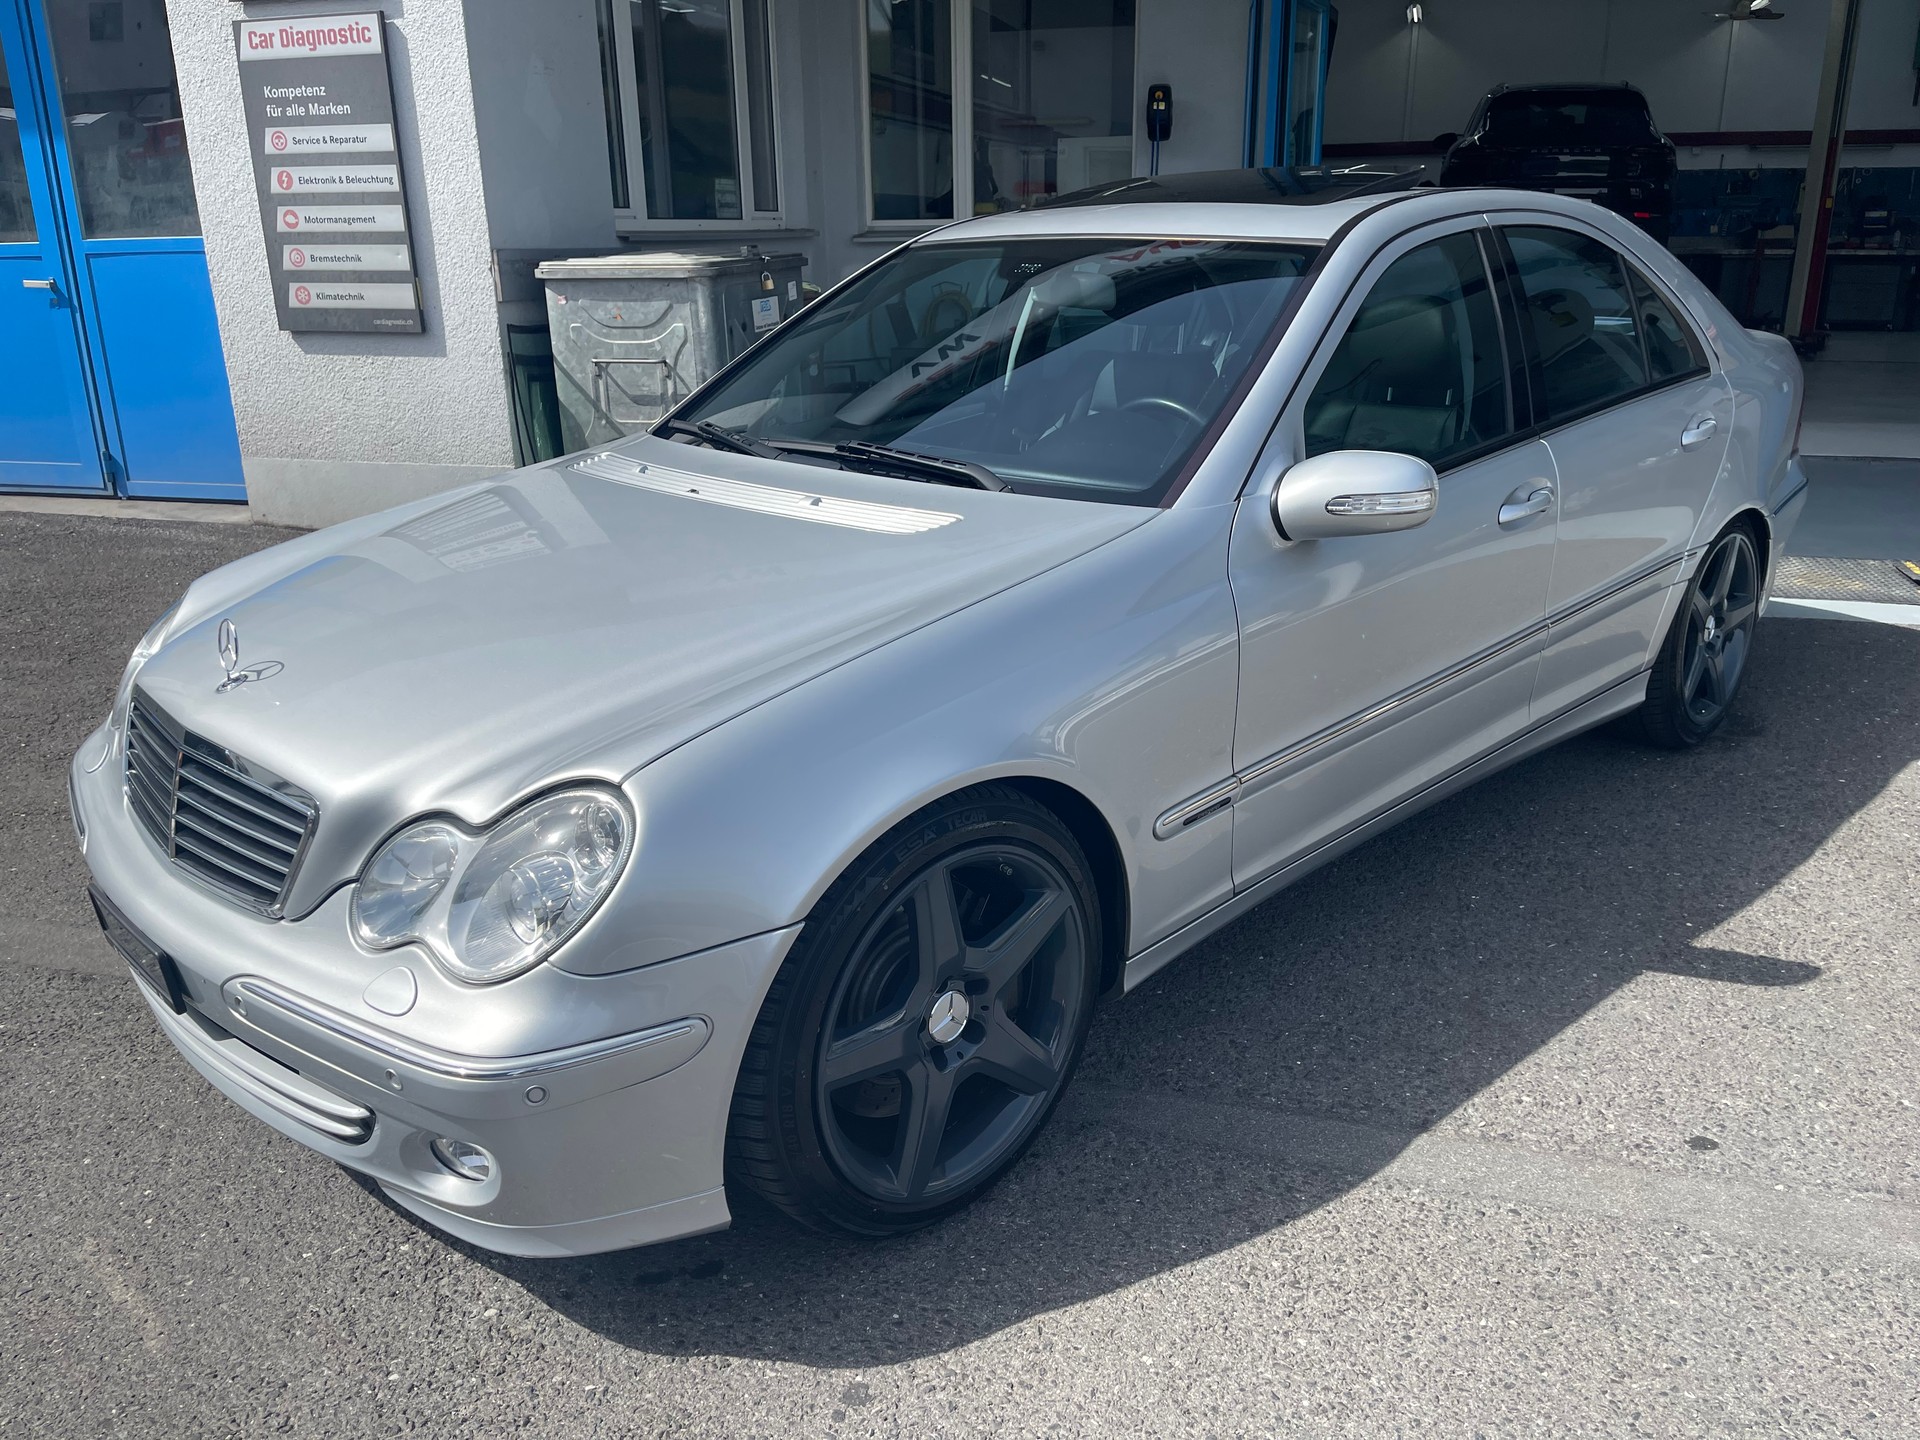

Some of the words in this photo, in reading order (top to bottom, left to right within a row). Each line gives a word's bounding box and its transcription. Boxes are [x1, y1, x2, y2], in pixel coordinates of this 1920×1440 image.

[247, 30, 275, 50] Car
[278, 21, 372, 52] Diagnostic
[263, 84, 327, 100] Kompetenz
[266, 105, 283, 117] für
[285, 103, 306, 116] alle
[308, 102, 351, 116] Marken
[292, 135, 321, 146] Service
[322, 135, 328, 145] &
[329, 135, 368, 146] Reparatur
[298, 176, 337, 186] Elektronik
[338, 175, 344, 185] &
[345, 174, 394, 186] Beleuchtung
[304, 214, 377, 226] Motormanagement
[310, 254, 363, 263] Bremstechnik
[315, 292, 366, 301] Klimatechnik
[373, 318, 414, 327] cardiagnostic.ch
